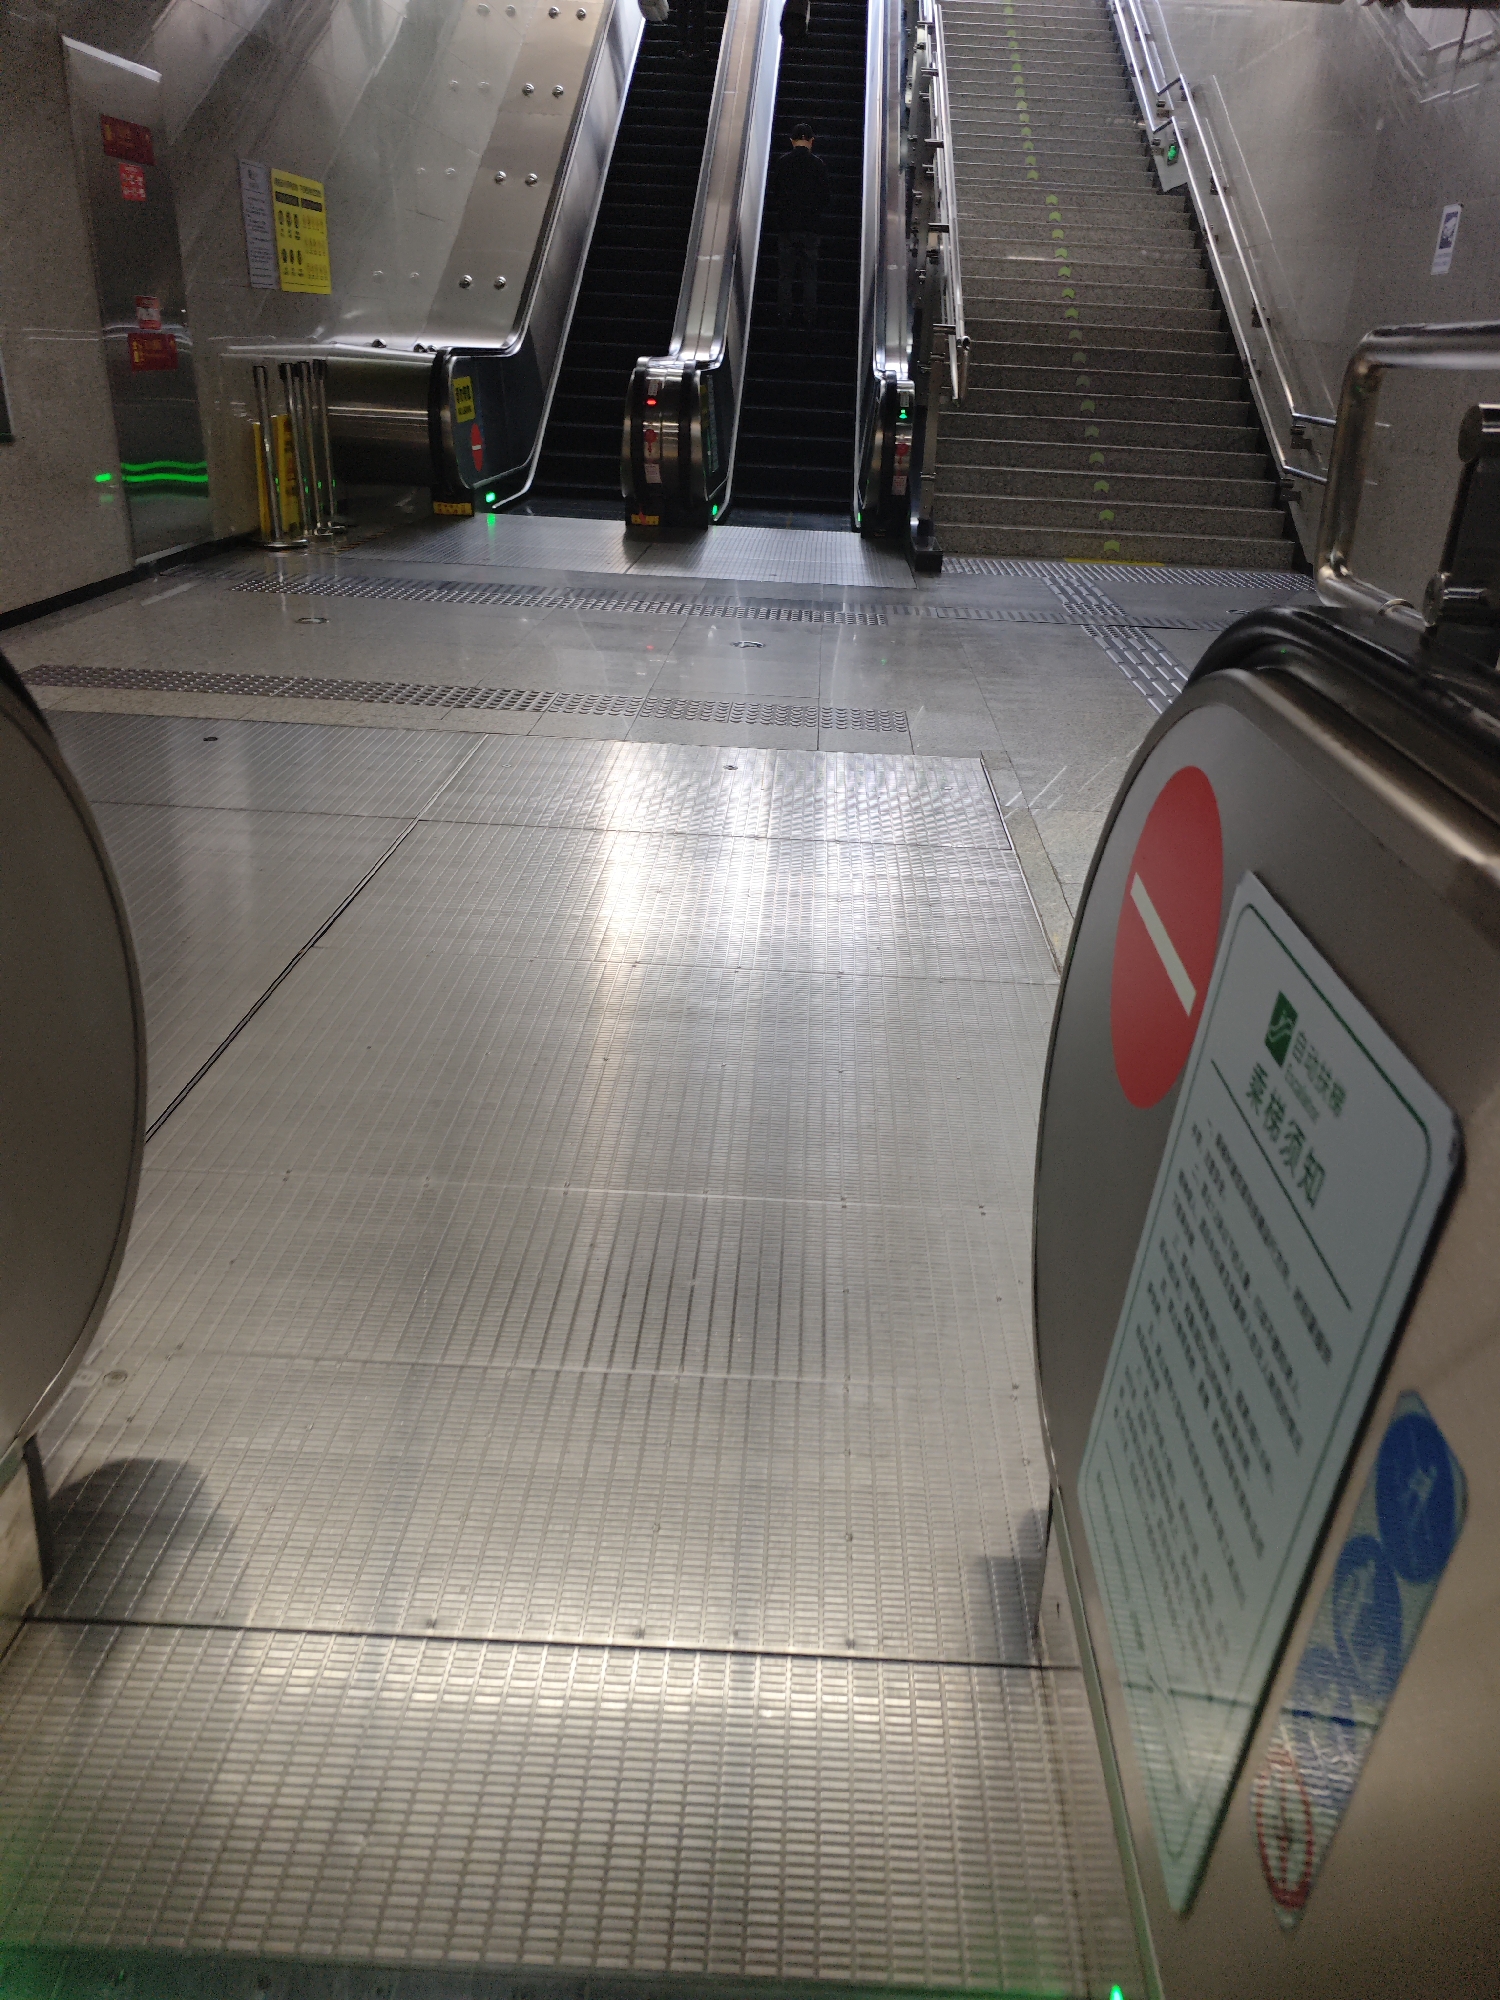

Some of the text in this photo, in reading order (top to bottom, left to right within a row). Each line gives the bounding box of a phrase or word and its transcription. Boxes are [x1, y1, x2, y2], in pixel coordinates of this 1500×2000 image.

[1292, 1030, 1347, 1118] 自动扶梯
[1245, 1062, 1326, 1209] 乘梯须知
